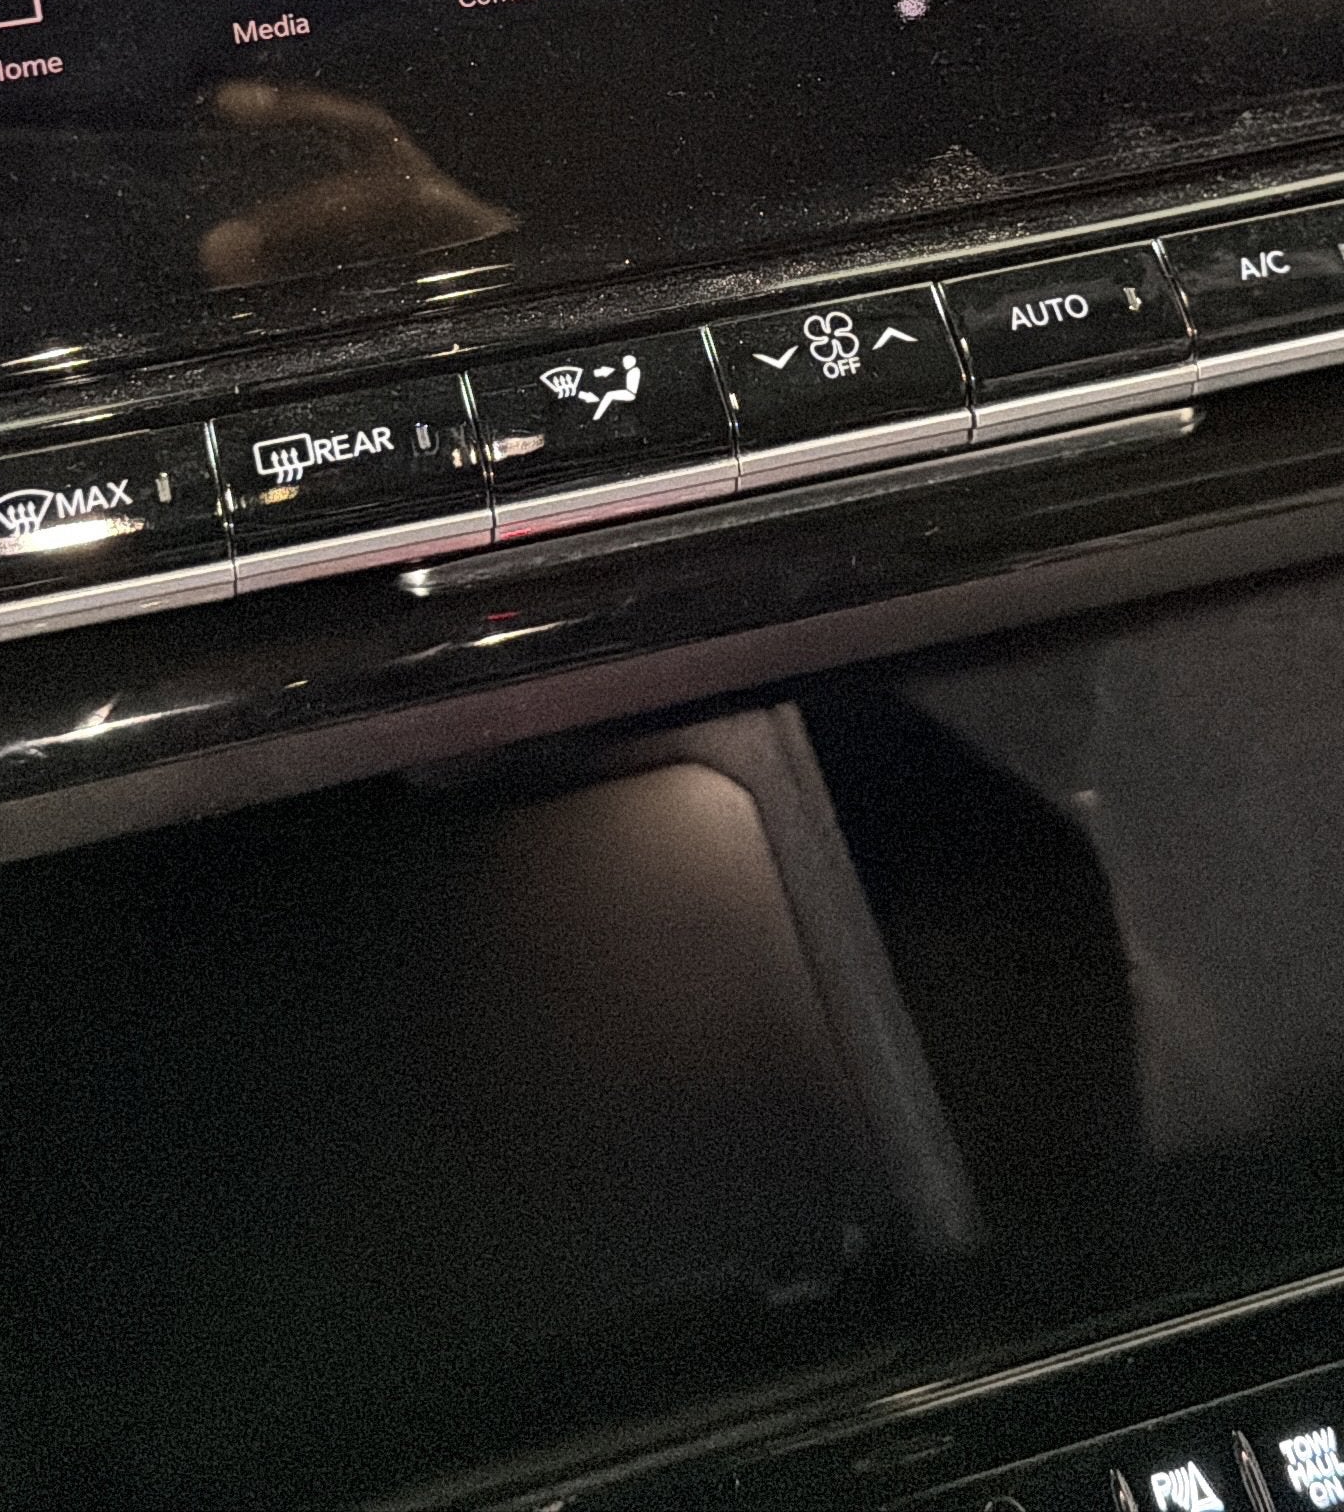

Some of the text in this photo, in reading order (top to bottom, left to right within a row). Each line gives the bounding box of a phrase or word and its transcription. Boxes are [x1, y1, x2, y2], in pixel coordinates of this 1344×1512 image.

[232, 13, 311, 45] Media
[1239, 249, 1292, 281] A/C
[1010, 292, 1090, 331] AUTO
[822, 356, 861, 379] OFF
[311, 426, 394, 466] REAR
[56, 477, 133, 517] MAX
